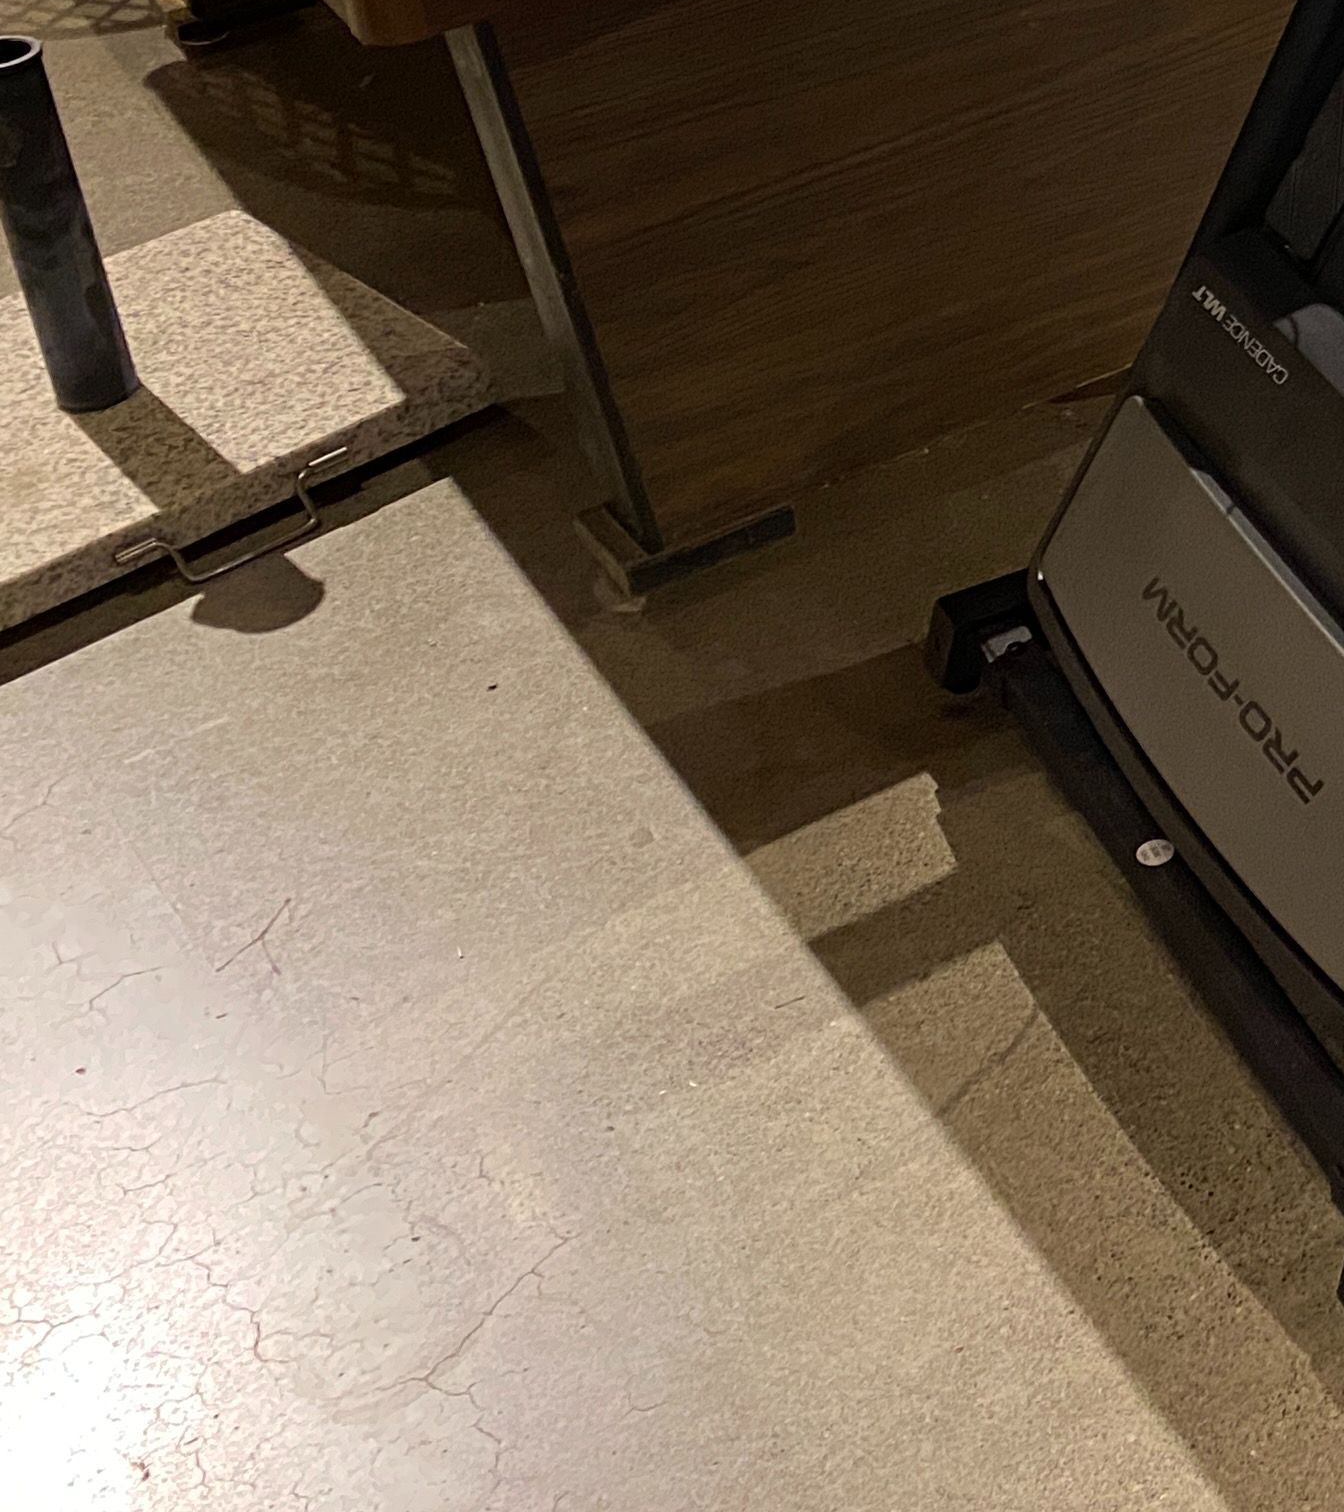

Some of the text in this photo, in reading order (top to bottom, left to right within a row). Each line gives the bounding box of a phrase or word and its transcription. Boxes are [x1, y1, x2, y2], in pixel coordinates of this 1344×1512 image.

[1192, 284, 1290, 386] CADENCE WLT
[1142, 577, 1325, 806] PRO-FORM
